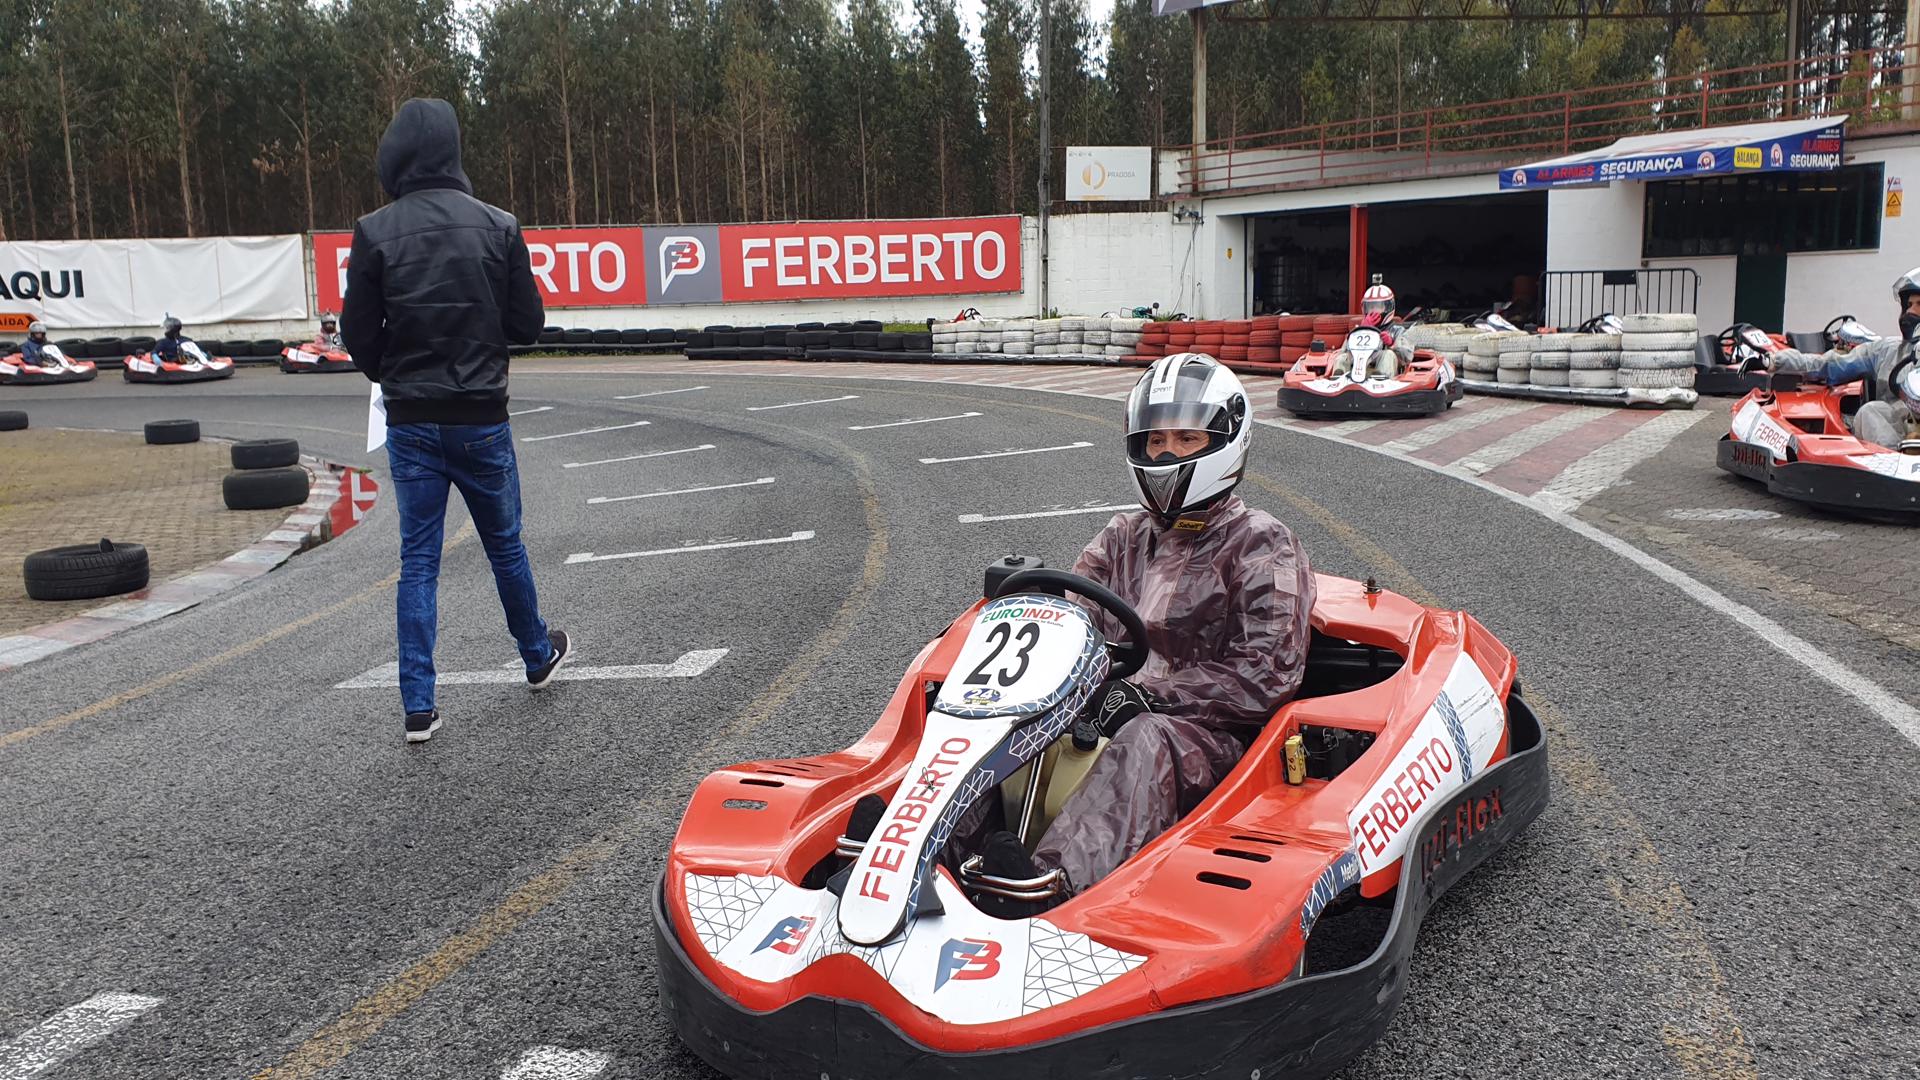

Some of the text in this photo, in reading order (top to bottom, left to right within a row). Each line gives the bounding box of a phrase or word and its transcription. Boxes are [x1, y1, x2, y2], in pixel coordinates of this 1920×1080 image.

[1536, 165, 1595, 181] ALARMES
[1600, 156, 1684, 176] SEGURANÇA
[1790, 154, 1840, 170] SEGURANÇA
[741, 230, 1006, 288] FERBERTO
[1356, 335, 1371, 346] 22
[981, 607, 1067, 624] EUROINDY
[962, 621, 1041, 687] 23
[859, 737, 971, 902] FERBERTO
[1354, 737, 1453, 871] FERBERTO
